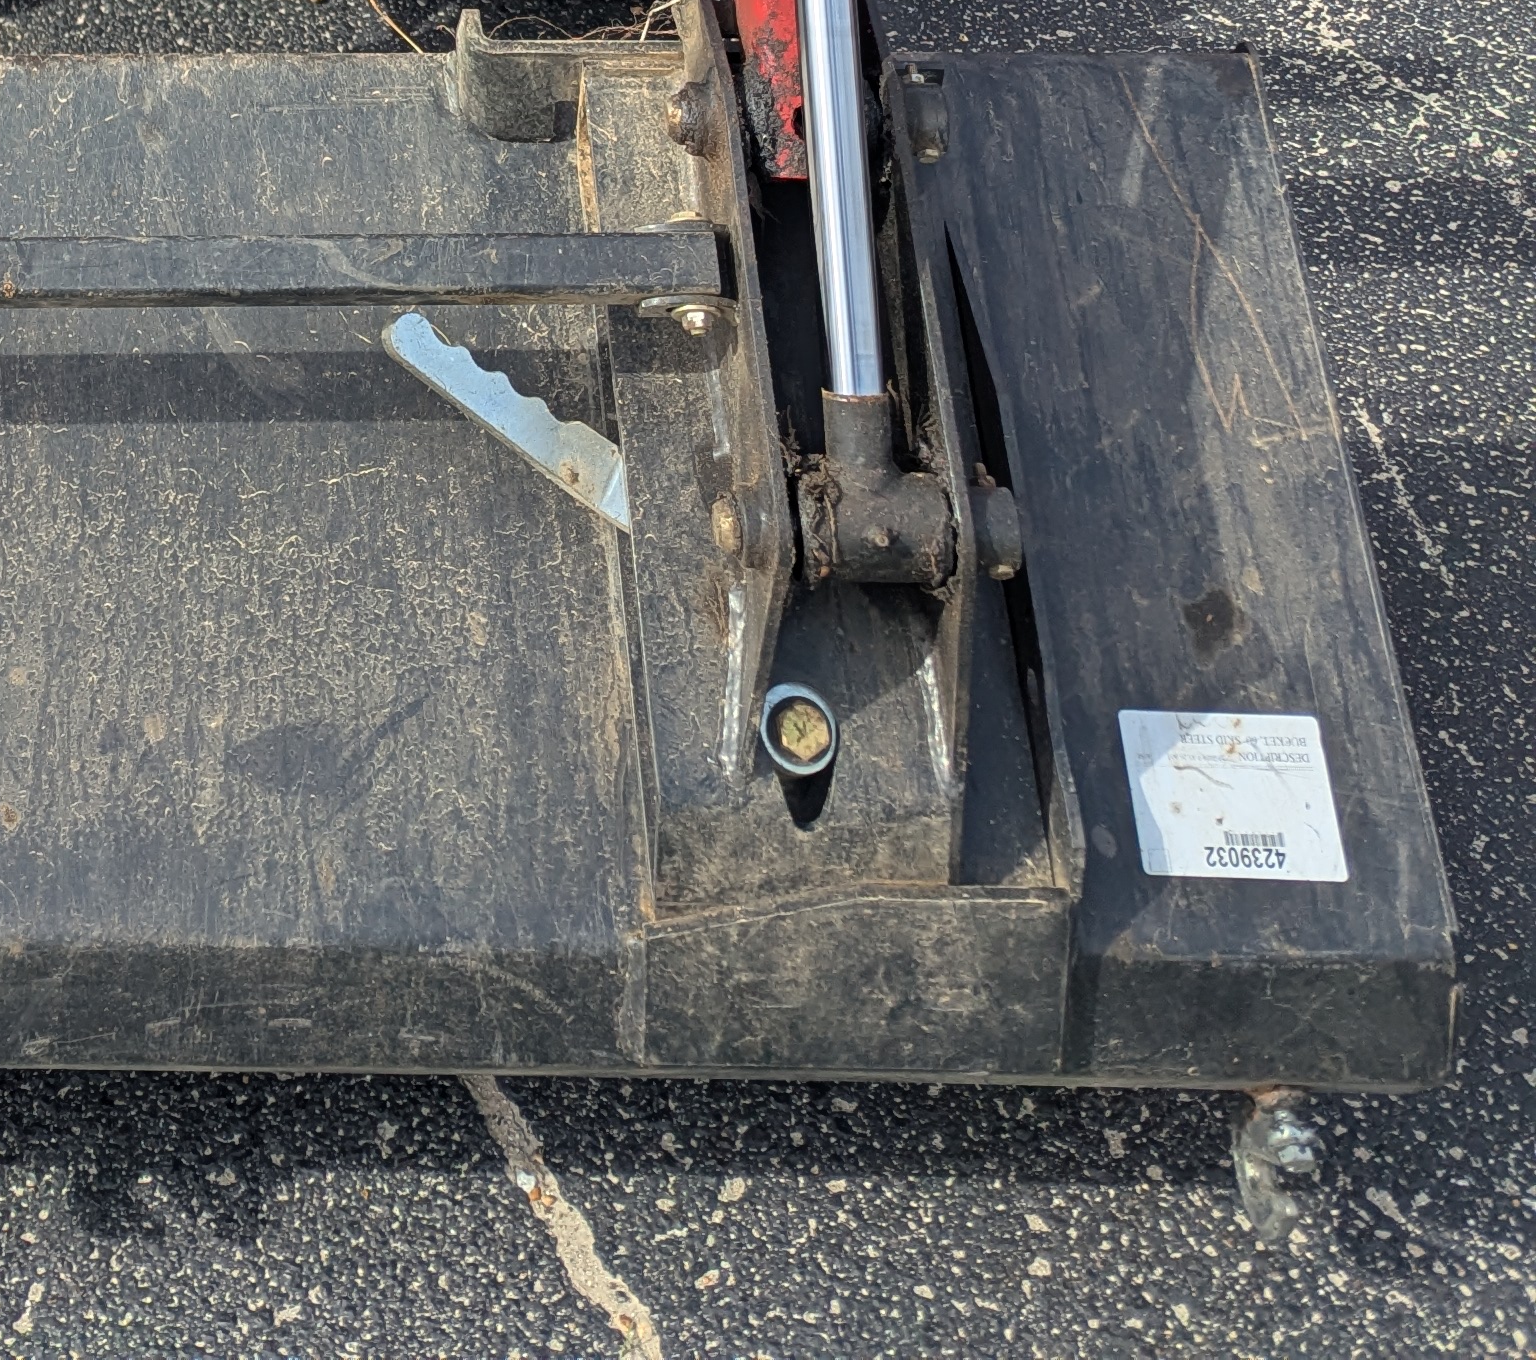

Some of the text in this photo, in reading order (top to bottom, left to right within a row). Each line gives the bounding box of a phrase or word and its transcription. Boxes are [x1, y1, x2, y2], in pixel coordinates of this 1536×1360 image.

[1179, 733, 1213, 745] STEER
[1215, 735, 1241, 746] SKID
[1238, 752, 1310, 763] DESCRIPTION
[1204, 846, 1286, 869] 4239032
